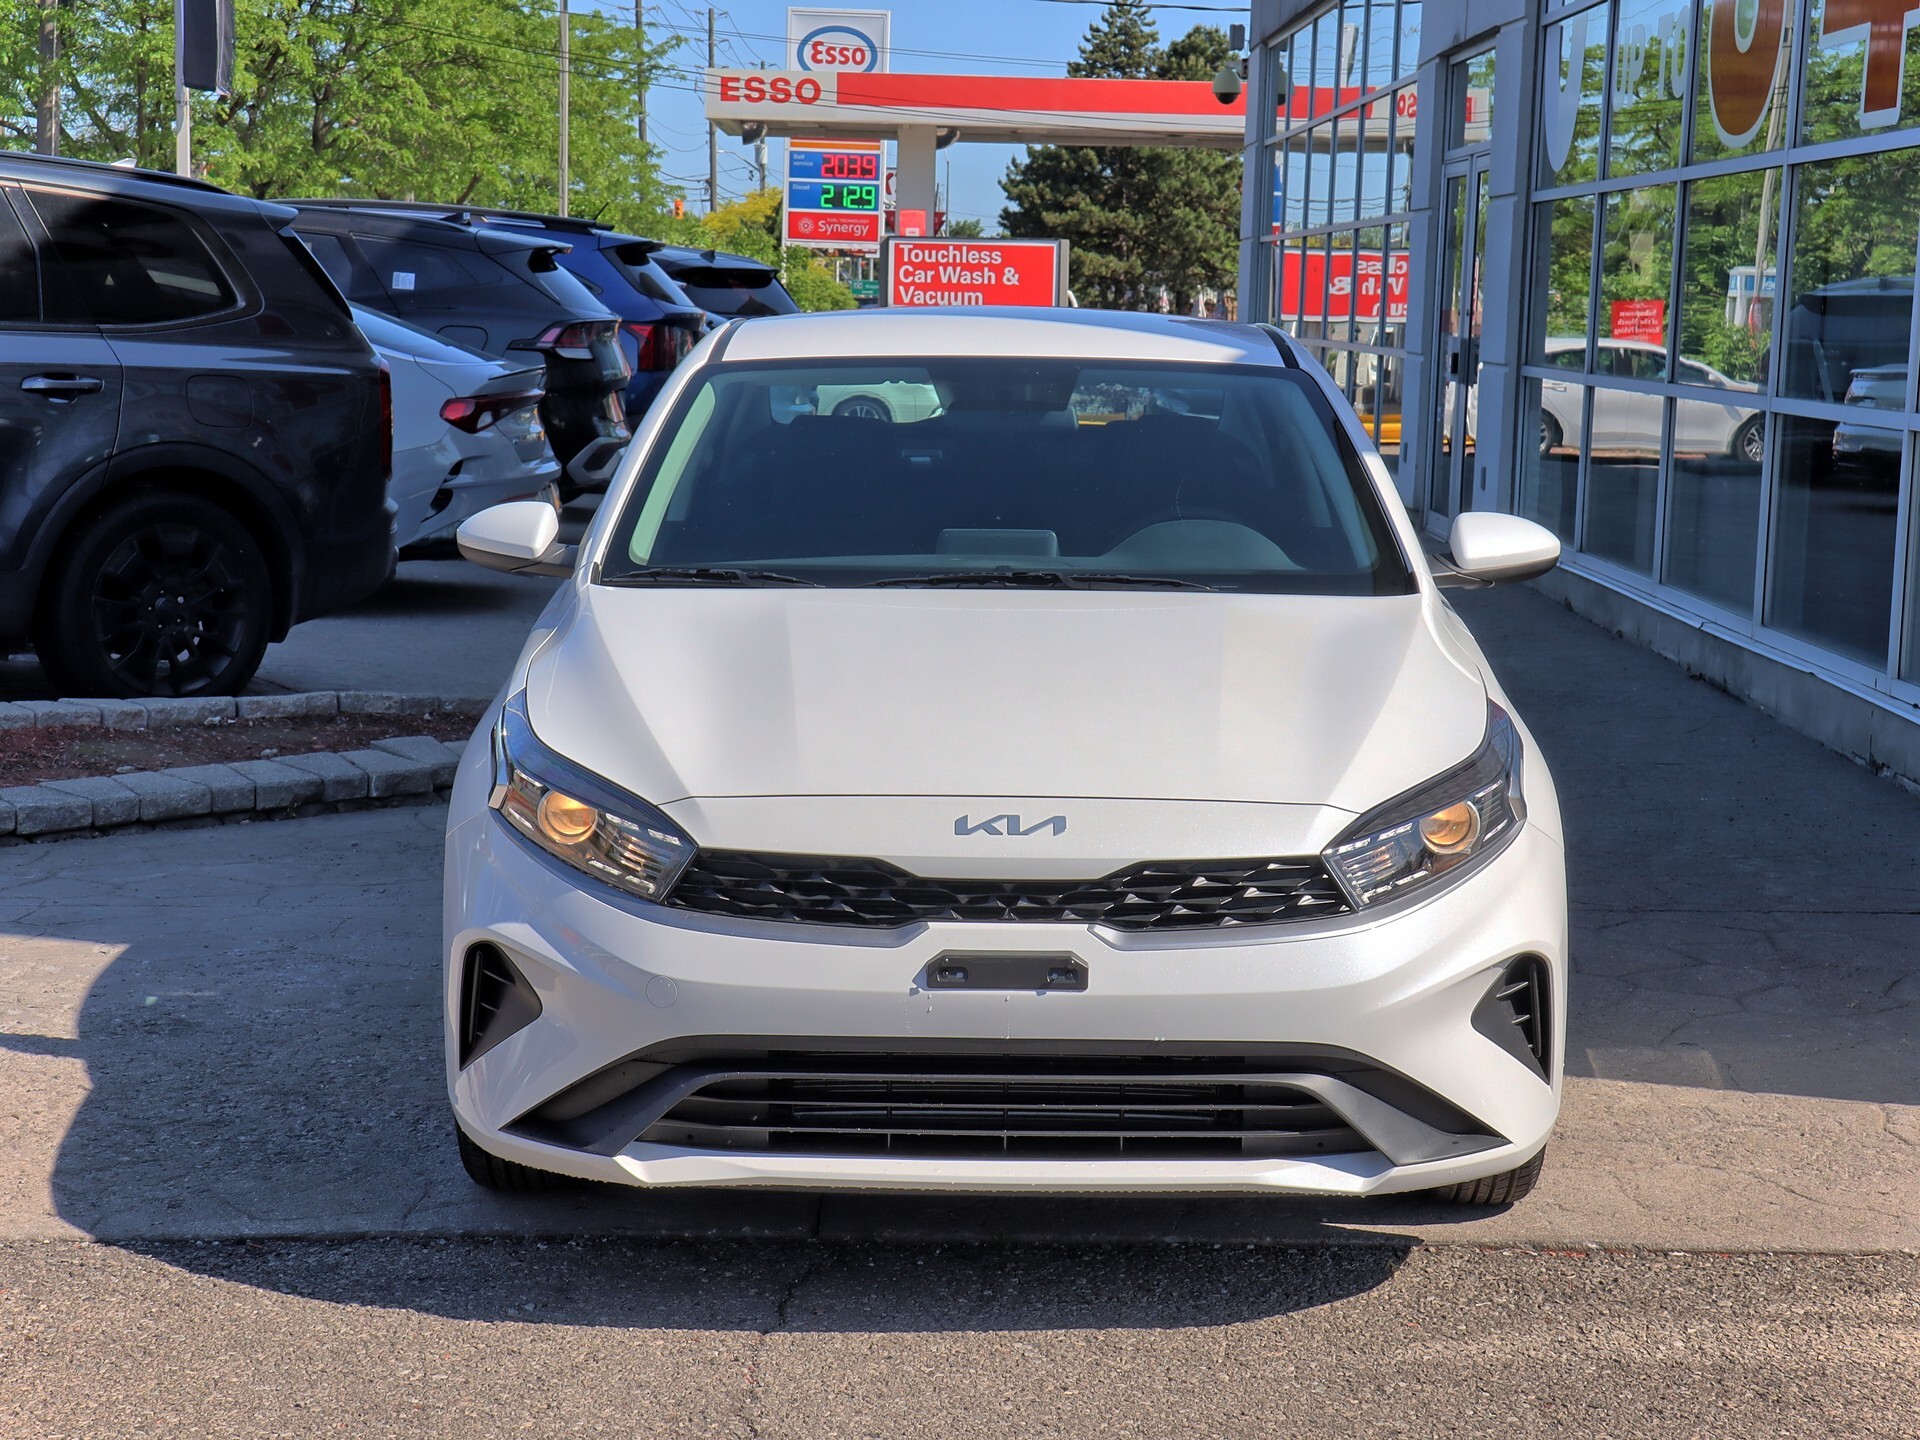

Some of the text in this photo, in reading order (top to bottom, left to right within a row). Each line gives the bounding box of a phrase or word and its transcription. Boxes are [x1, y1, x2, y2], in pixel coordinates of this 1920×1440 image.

[811, 41, 866, 65] Esso
[1612, 24, 1647, 112] UP
[1657, 4, 1690, 100] TO
[720, 76, 822, 105] ESSO
[818, 220, 869, 236] Synergy
[899, 244, 1002, 264] Touchless
[899, 265, 1019, 285] Car Wash &
[899, 286, 983, 305] Vacuum
[954, 814, 1067, 836] KIA
